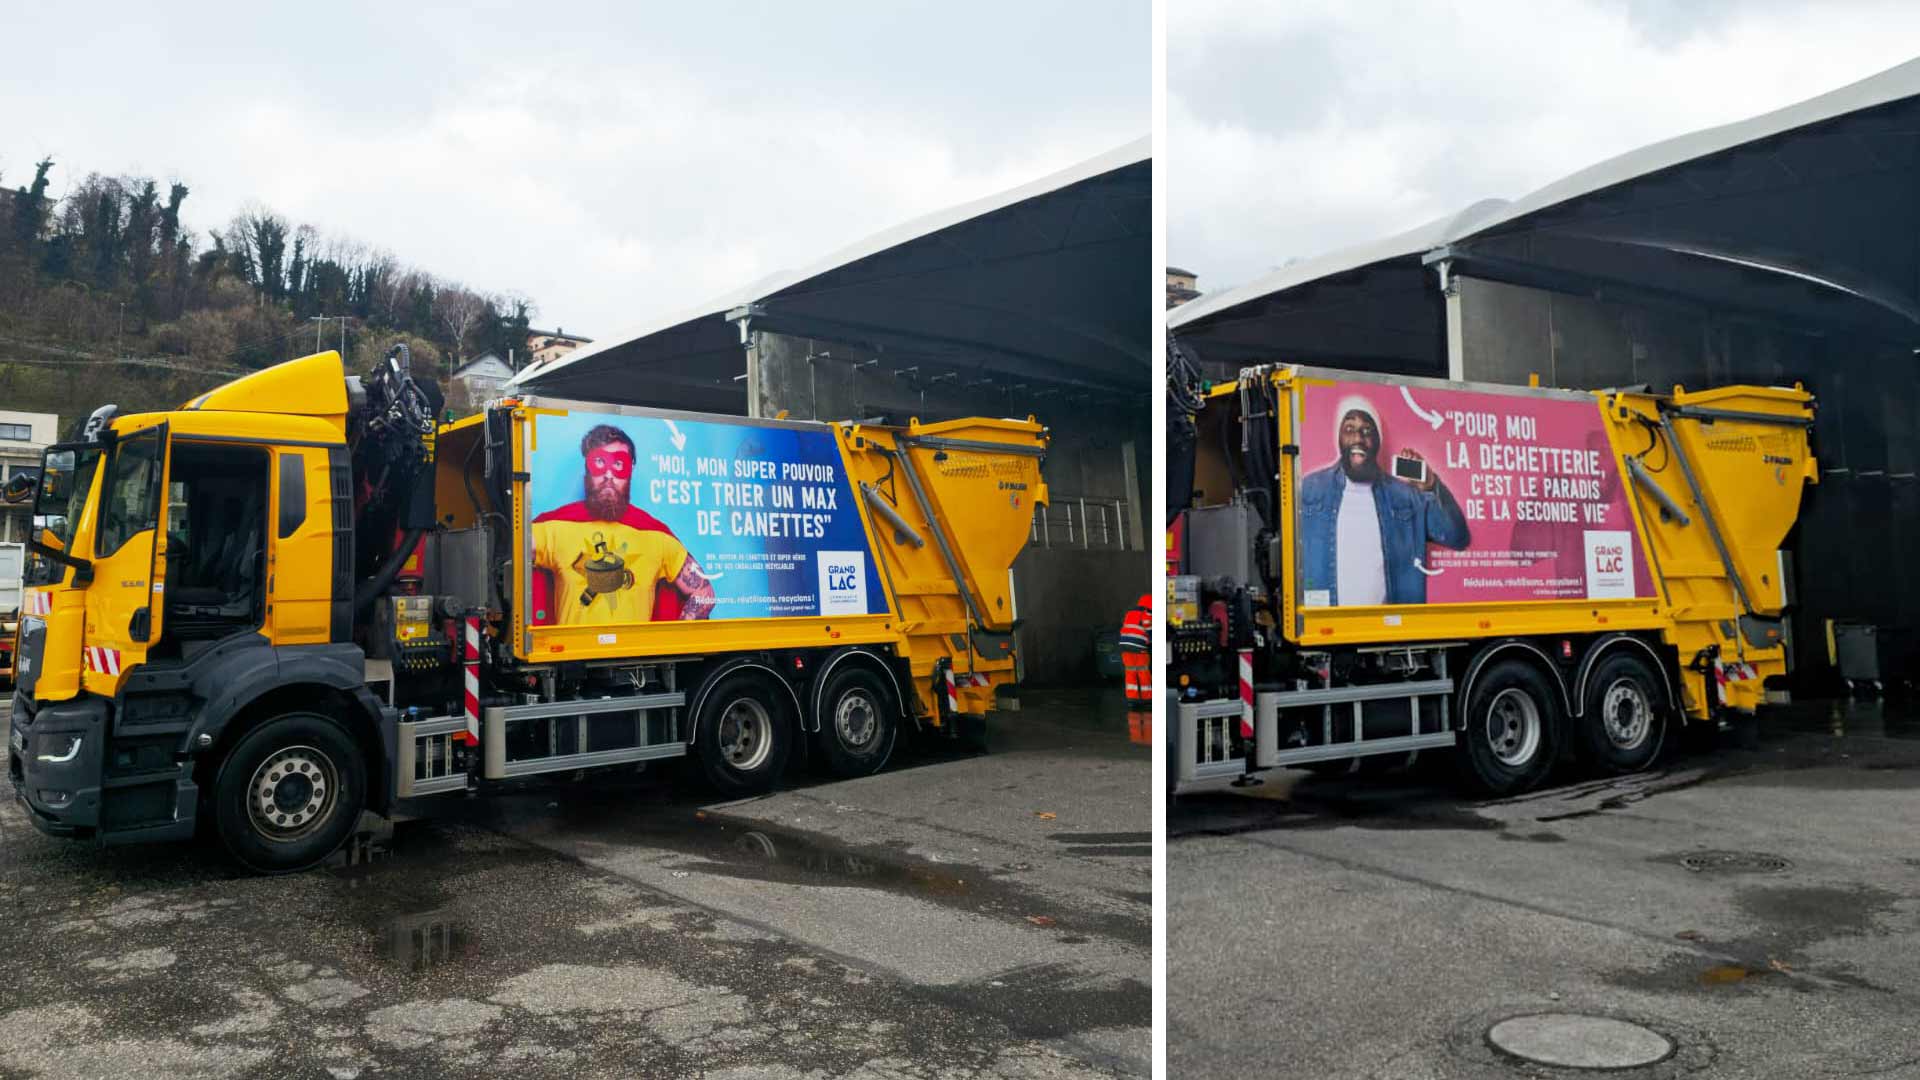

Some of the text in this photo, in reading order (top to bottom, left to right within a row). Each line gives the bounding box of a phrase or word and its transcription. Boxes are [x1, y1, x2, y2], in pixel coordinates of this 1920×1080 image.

[1506, 415, 1537, 440] MOI
[697, 458, 728, 477] MON
[734, 459, 776, 479] SUPER
[782, 462, 834, 482] POUVOIR
[1446, 437, 1606, 479] LA DÉCHETTERIE,
[650, 479, 838, 510] C'EST TRIER UN MAX
[1471, 474, 1600, 499] C'EST LE PARADIS
[697, 511, 722, 535] DE
[1467, 499, 1486, 520] DE
[1492, 500, 1511, 521] LA
[1517, 502, 1578, 523] SECONDE
[1595, 546, 1622, 555] GRAND
[828, 565, 855, 574] GRAND
[1596, 556, 1623, 573] LAC
[829, 575, 857, 591] LAC
